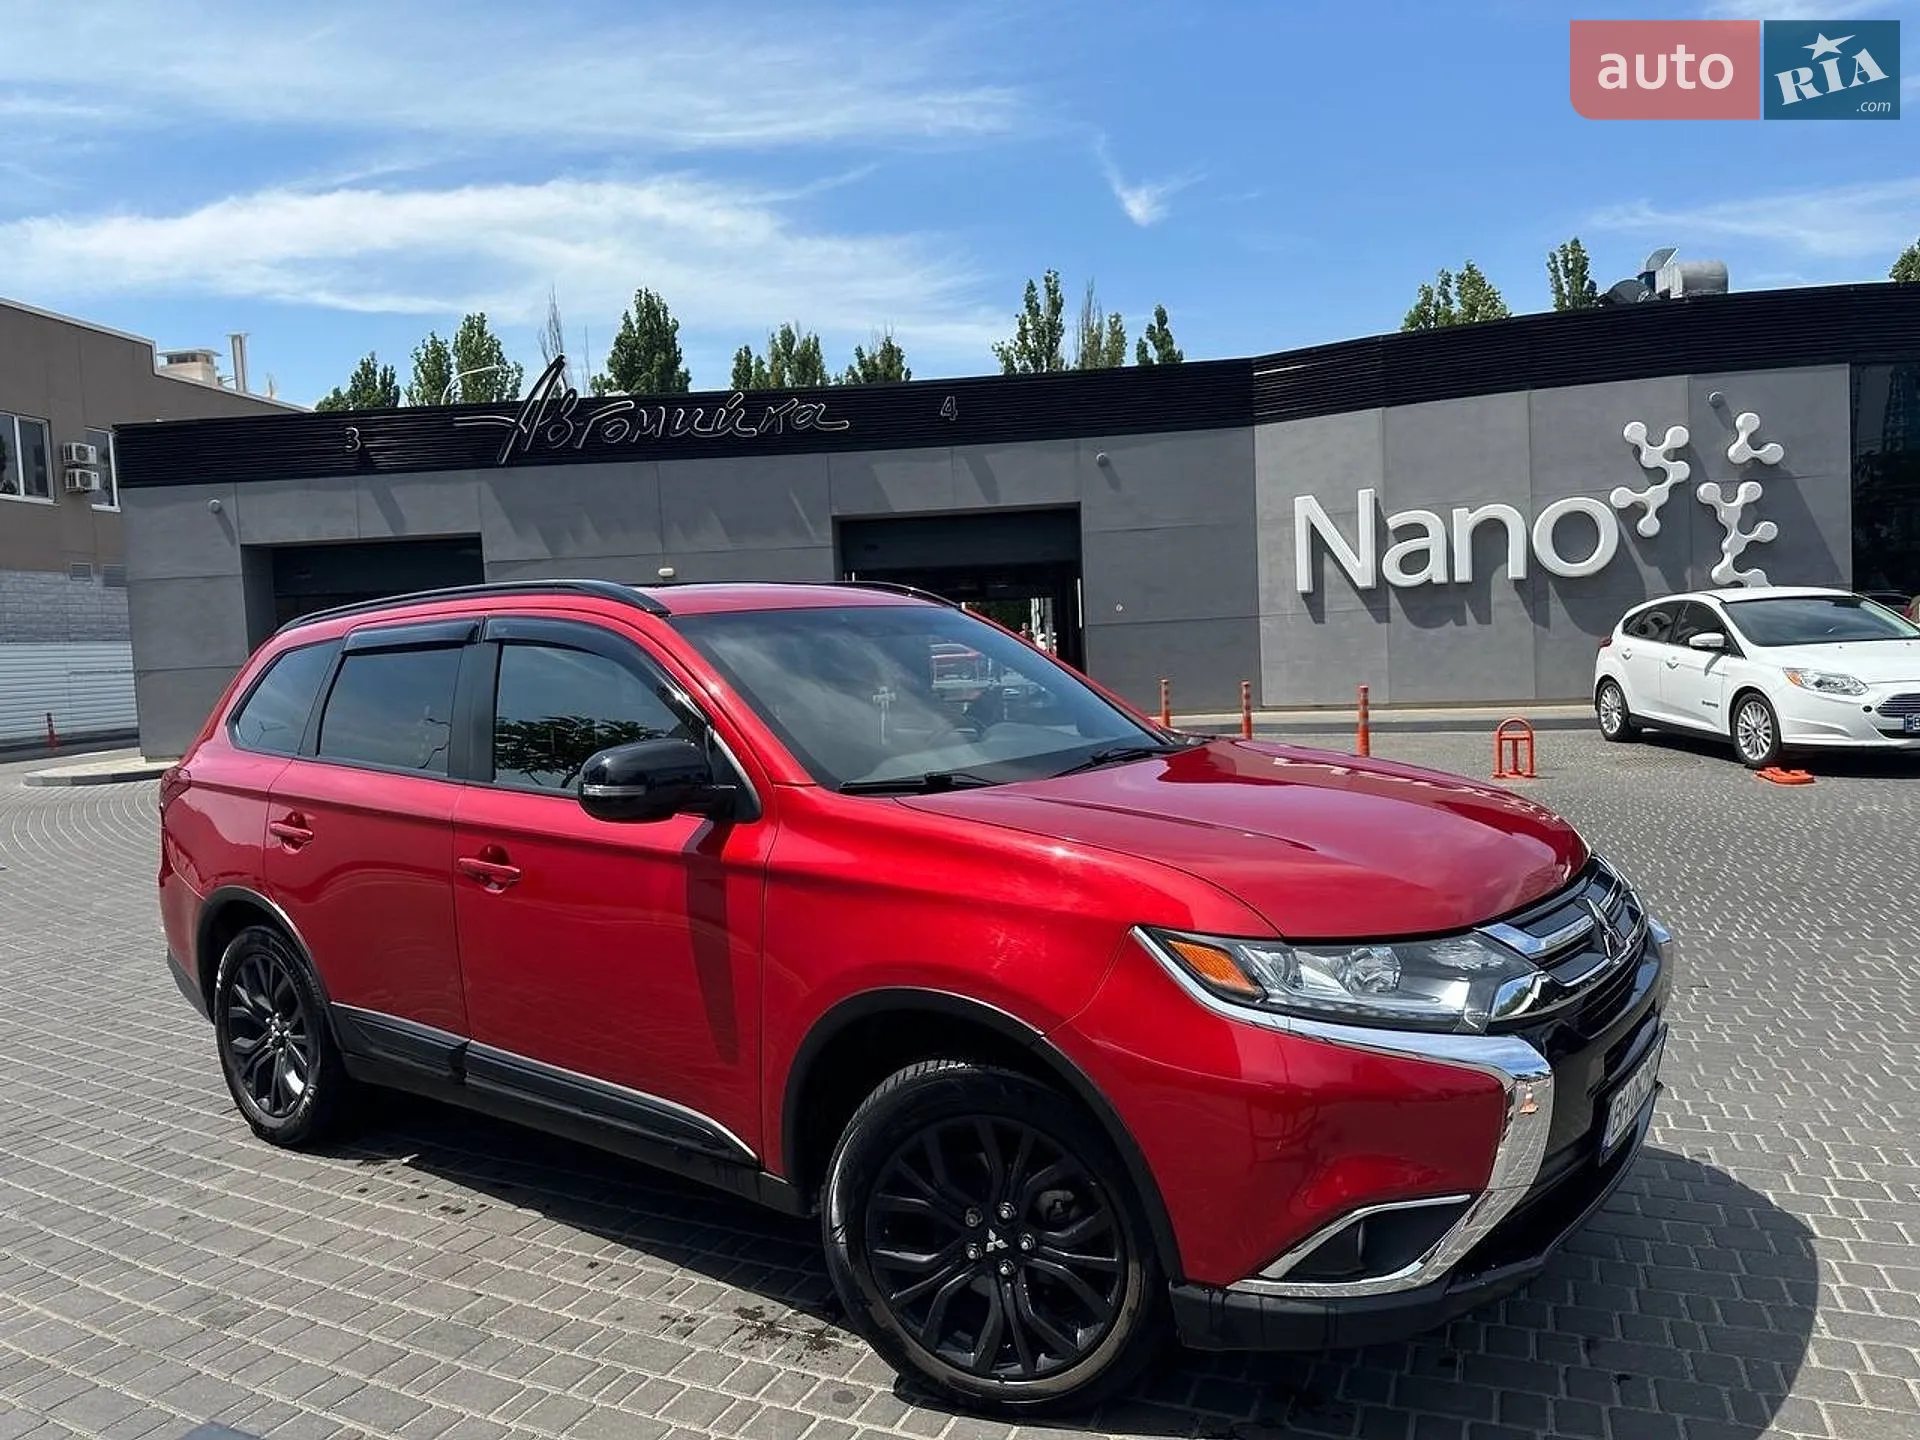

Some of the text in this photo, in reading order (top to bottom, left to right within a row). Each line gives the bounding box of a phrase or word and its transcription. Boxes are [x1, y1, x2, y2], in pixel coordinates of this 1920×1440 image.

[940, 395, 959, 421] 4
[344, 426, 361, 453] 3
[1294, 488, 1619, 594] Nano
